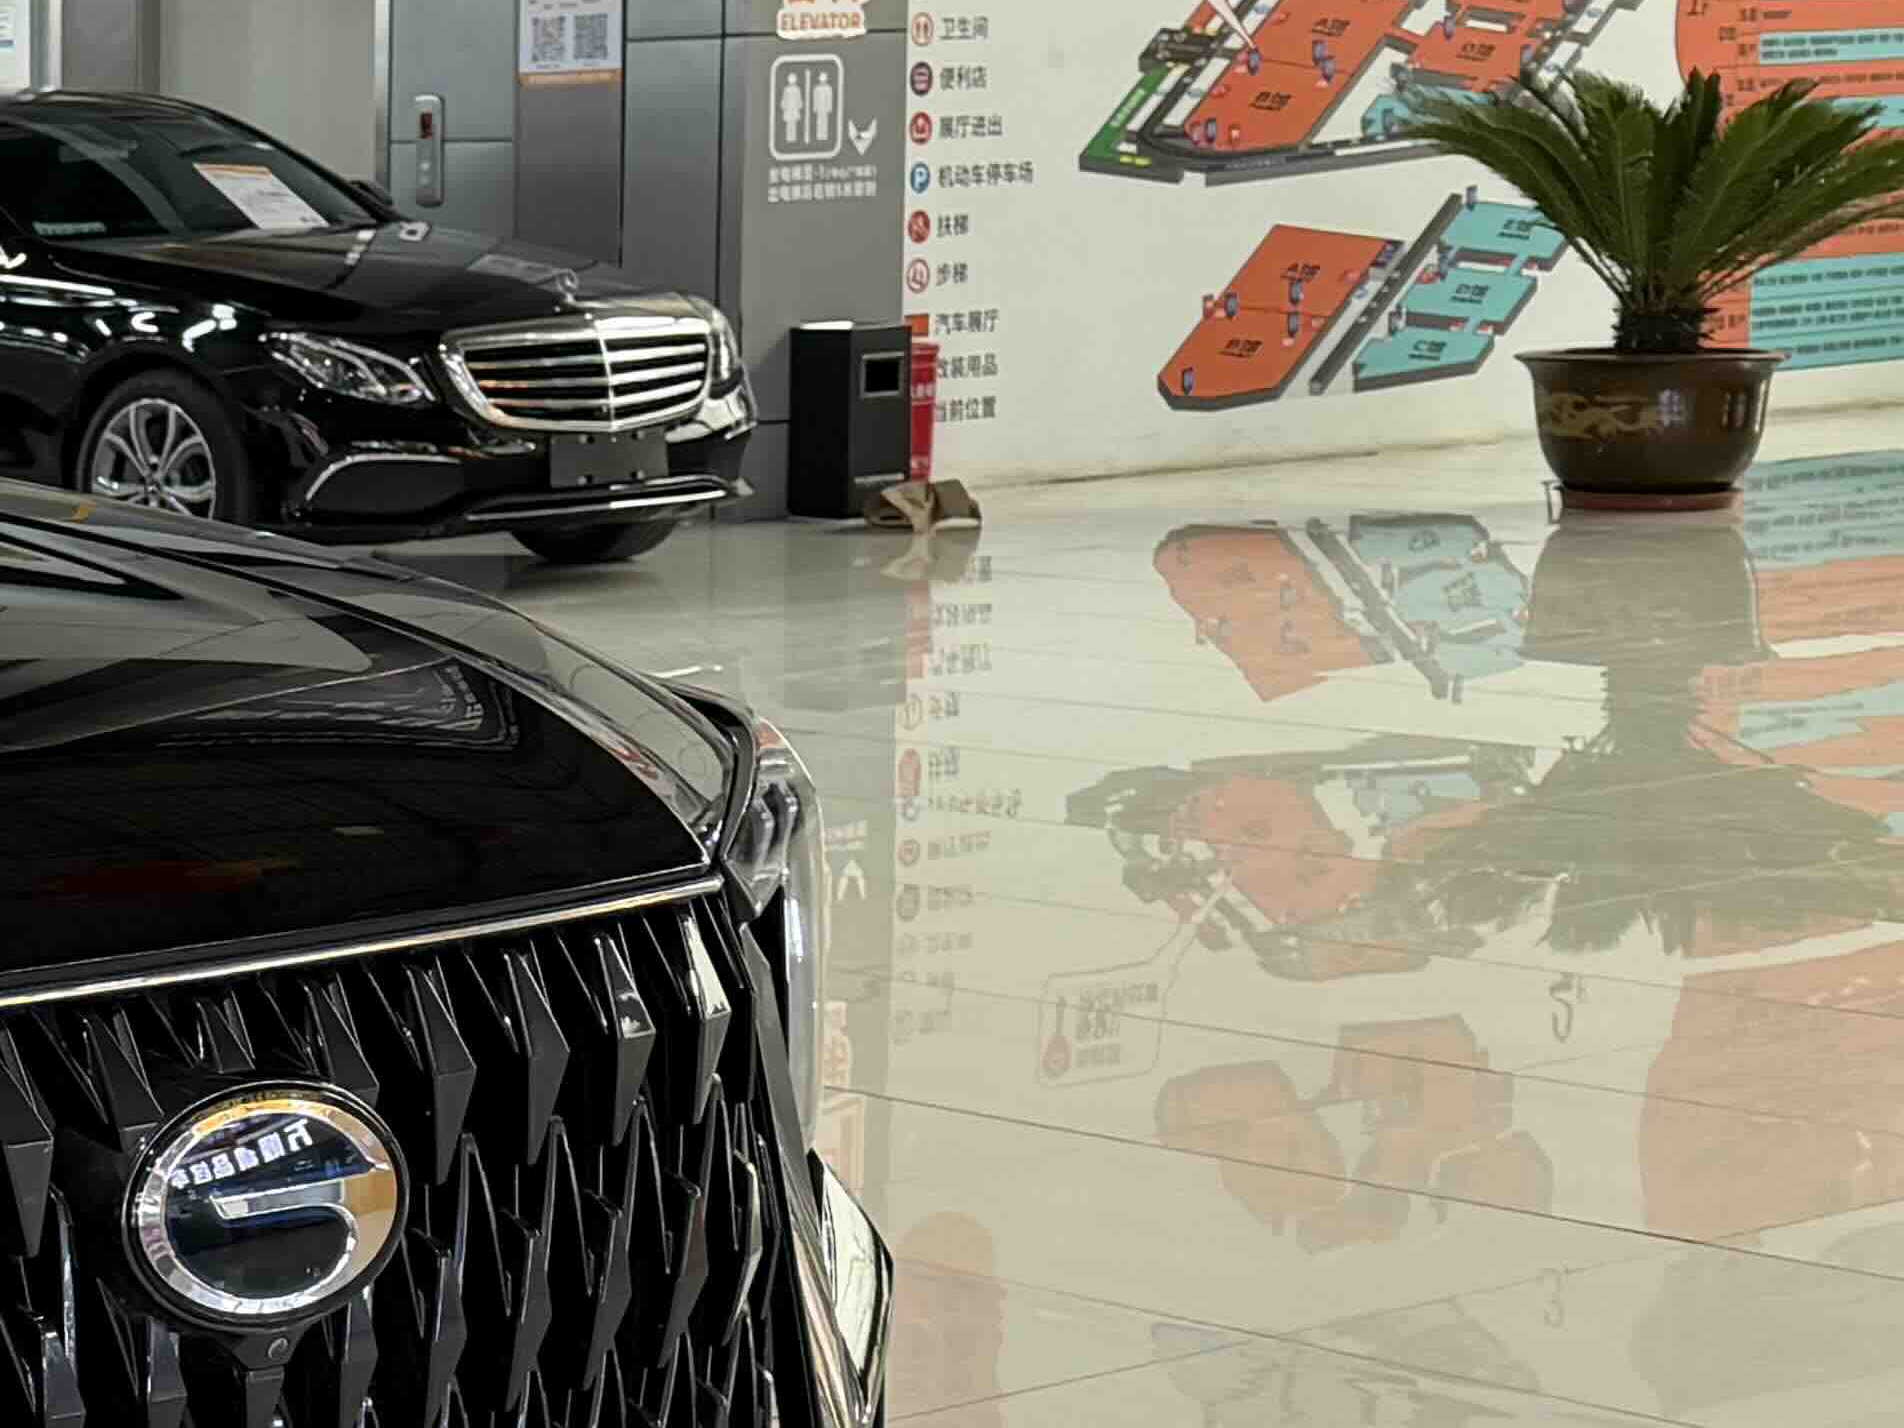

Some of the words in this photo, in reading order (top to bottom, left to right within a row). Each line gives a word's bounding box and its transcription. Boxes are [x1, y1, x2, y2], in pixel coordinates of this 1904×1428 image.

[780, 11, 862, 31] ELEVATOR
[940, 16, 989, 40] 卫生间
